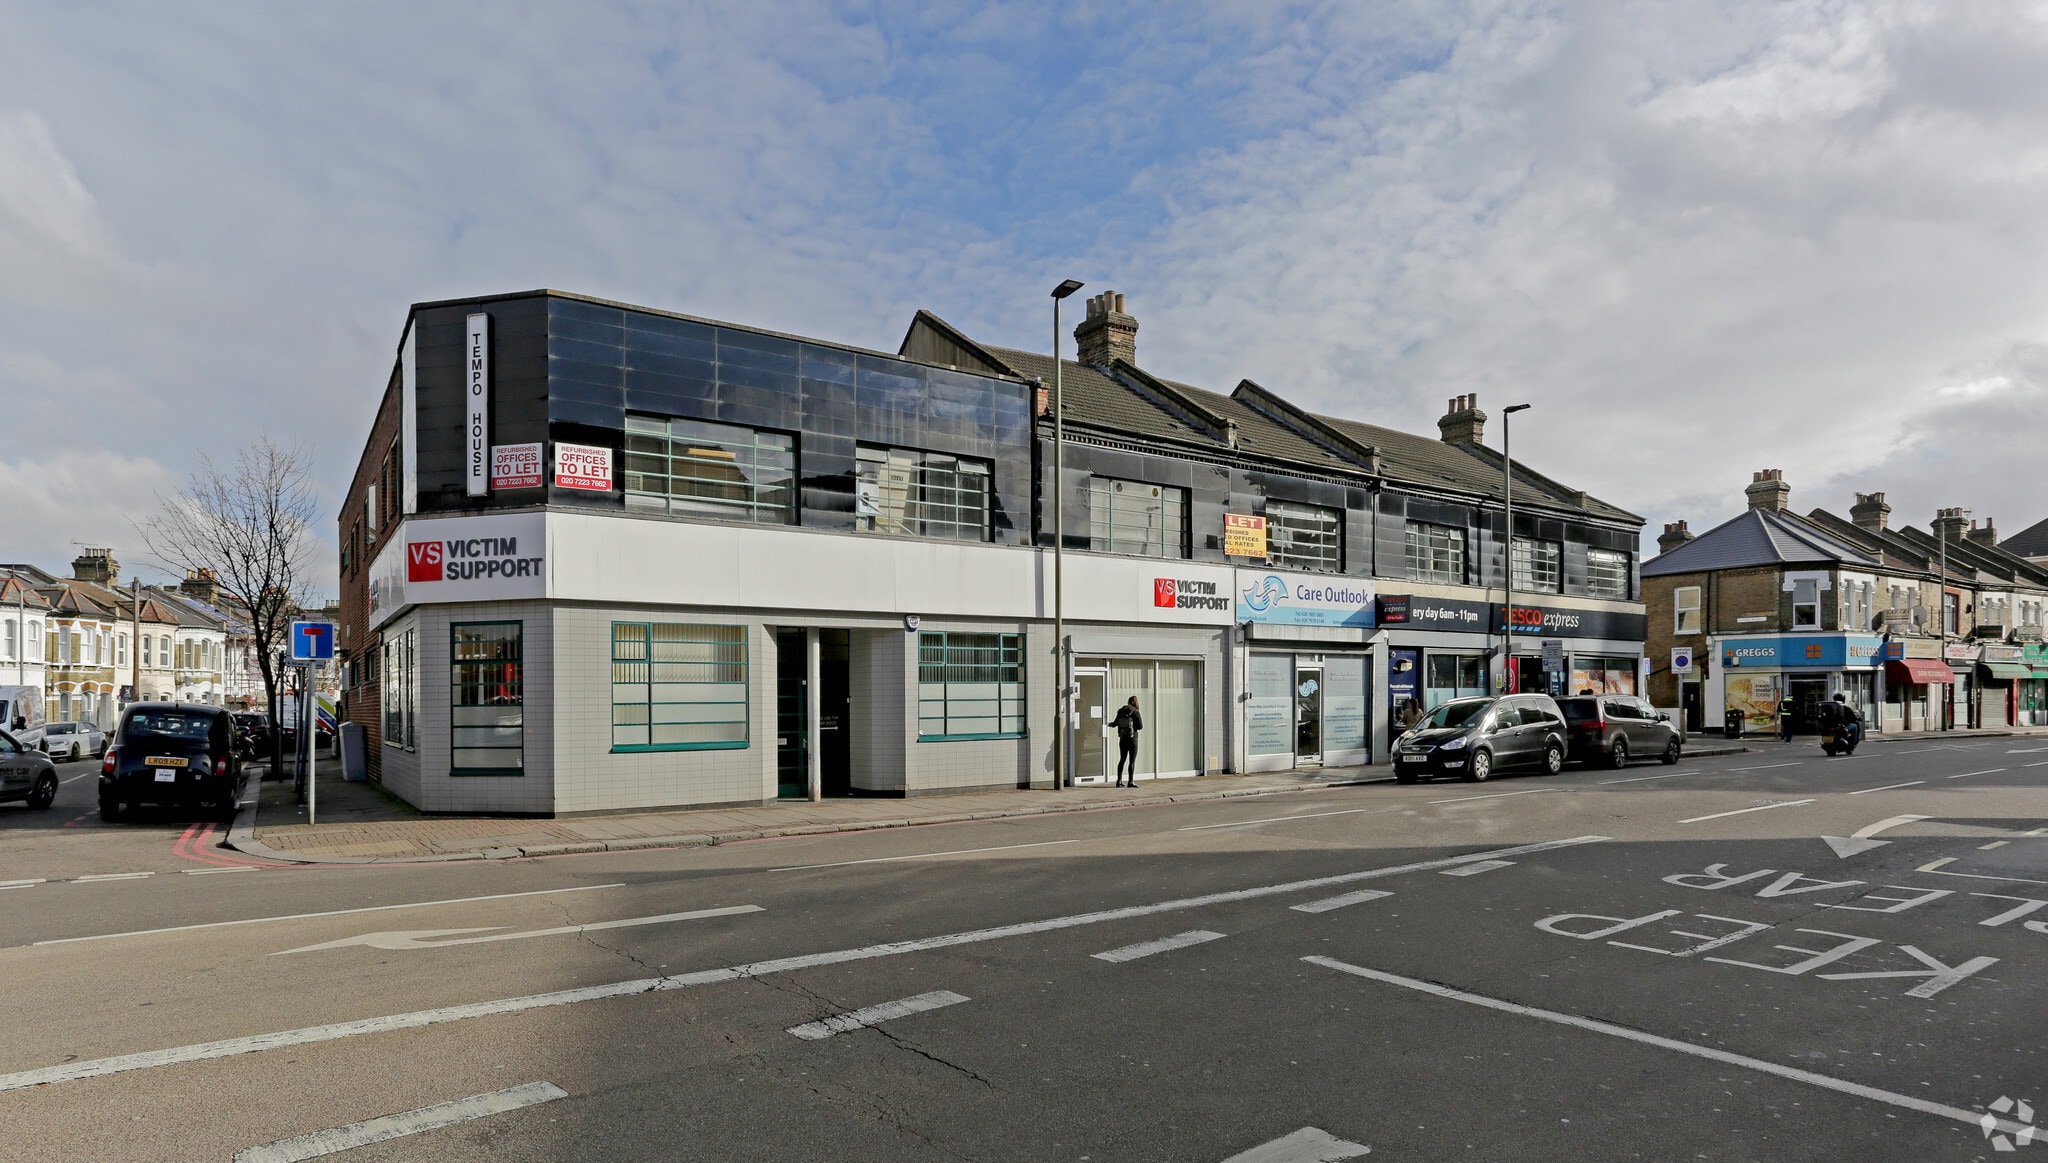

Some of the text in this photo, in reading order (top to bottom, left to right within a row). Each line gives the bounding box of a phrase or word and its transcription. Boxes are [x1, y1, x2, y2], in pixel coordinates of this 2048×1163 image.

[472, 333, 482, 477] TEMPO HOUSE
[496, 446, 537, 454] REFURBISHED
[497, 452, 537, 463] OFFICES
[561, 446, 606, 456] REFURBISHED
[562, 452, 606, 466] OFFICES
[494, 462, 539, 475] TO LET
[559, 462, 608, 478] TO LET
[1228, 516, 1258, 528] LET
[410, 543, 440, 565] VS
[446, 537, 517, 558] VICTIM
[446, 558, 543, 580] SUPPORT
[1156, 579, 1174, 595] VS
[1176, 580, 1216, 595] VICTIM
[1297, 584, 1370, 604] Care Outlook
[1176, 595, 1230, 610] SUPPORT
[1384, 606, 1406, 614] express
[1426, 607, 1438, 620] day
[1440, 608, 1454, 619] 6am
[1460, 610, 1478, 622] 11pm
[1544, 612, 1580, 632] express
[1736, 648, 1774, 656] GREGGS
[1857, 645, 1879, 656] GREGGS
[1534, 909, 2000, 999] KEEP
